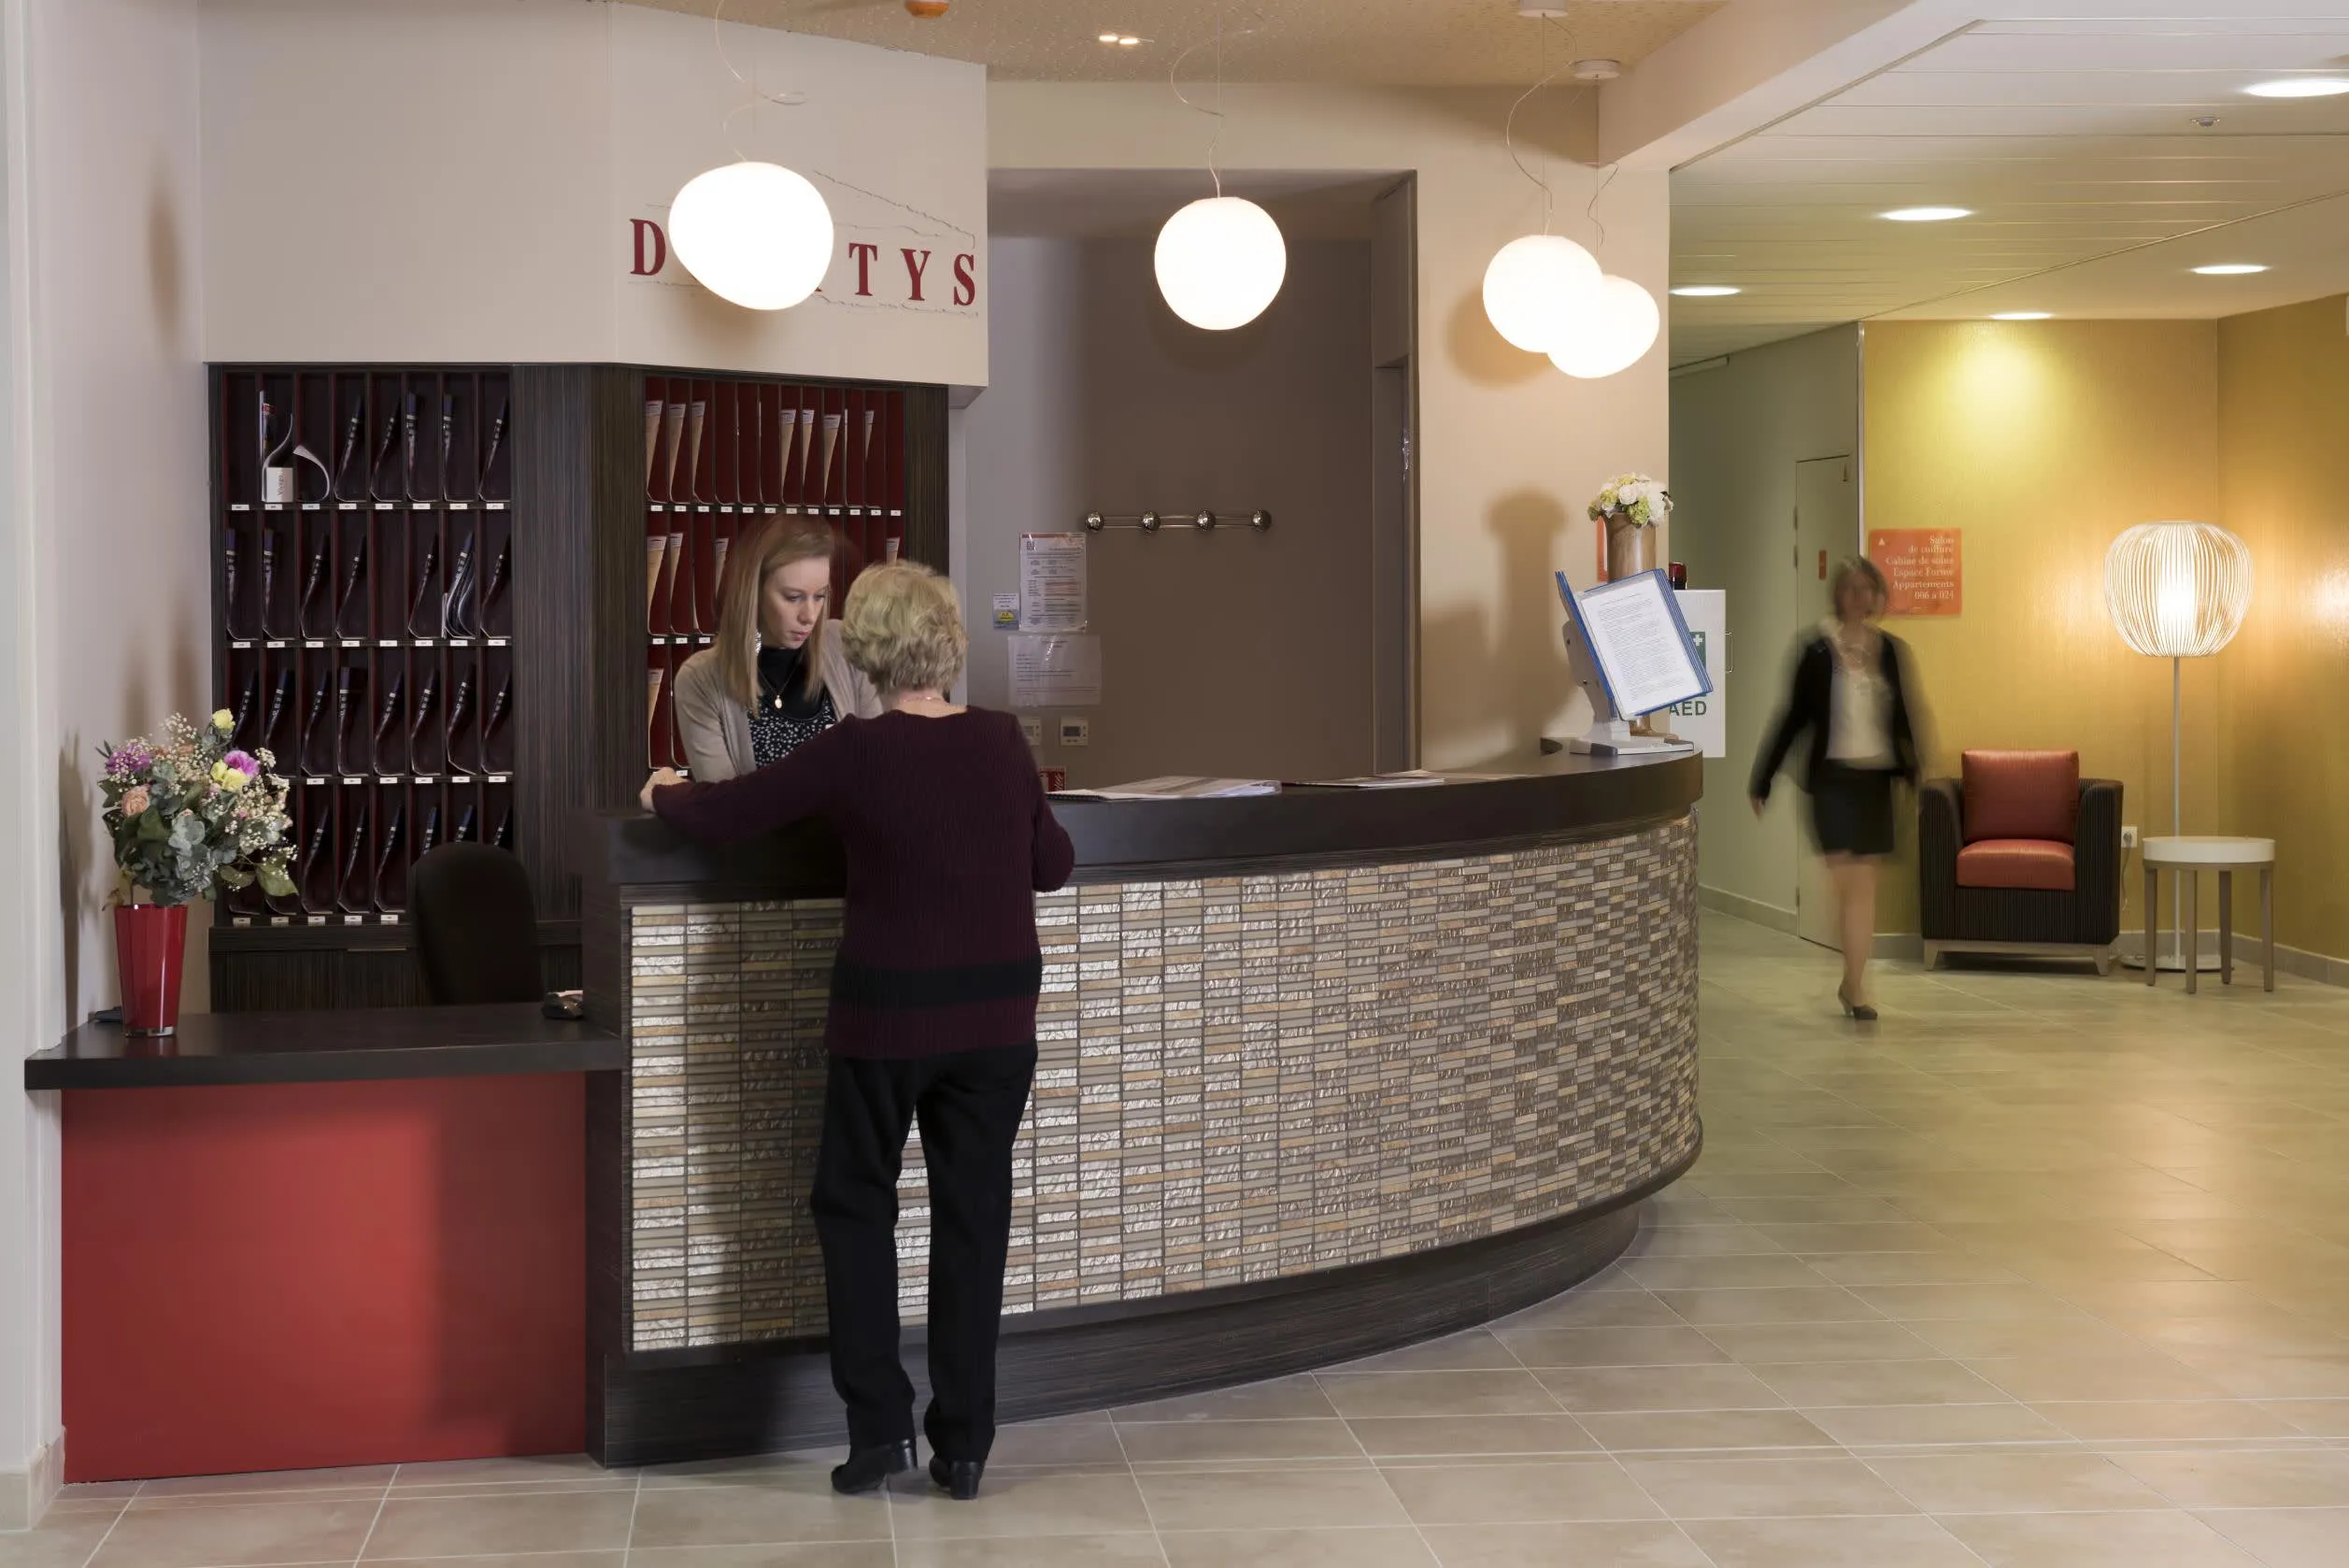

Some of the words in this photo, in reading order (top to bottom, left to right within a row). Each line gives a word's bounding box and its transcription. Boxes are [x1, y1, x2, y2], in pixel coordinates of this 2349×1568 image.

[629, 218, 975, 306] DTYS
[1892, 579, 1954, 591] Appartements
[1670, 701, 1707, 716] AED
